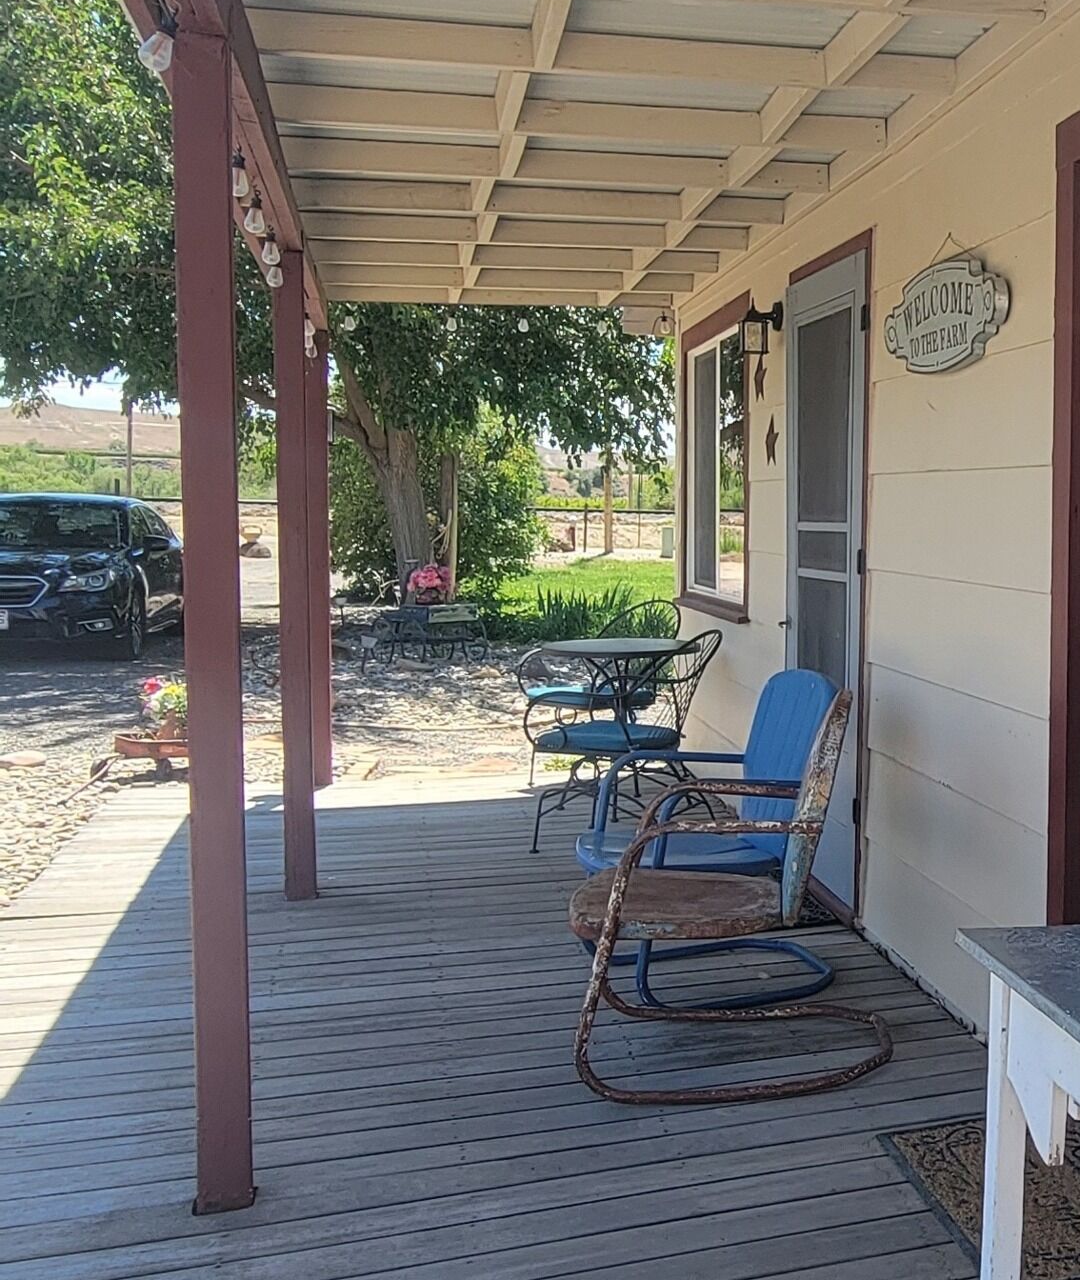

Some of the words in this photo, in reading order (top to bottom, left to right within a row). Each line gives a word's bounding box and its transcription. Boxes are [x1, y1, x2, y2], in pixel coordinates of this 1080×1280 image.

[903, 282, 973, 335] WELCOME
[910, 337, 920, 359] TO
[921, 330, 938, 355] THE
[940, 321, 968, 351] FARM
